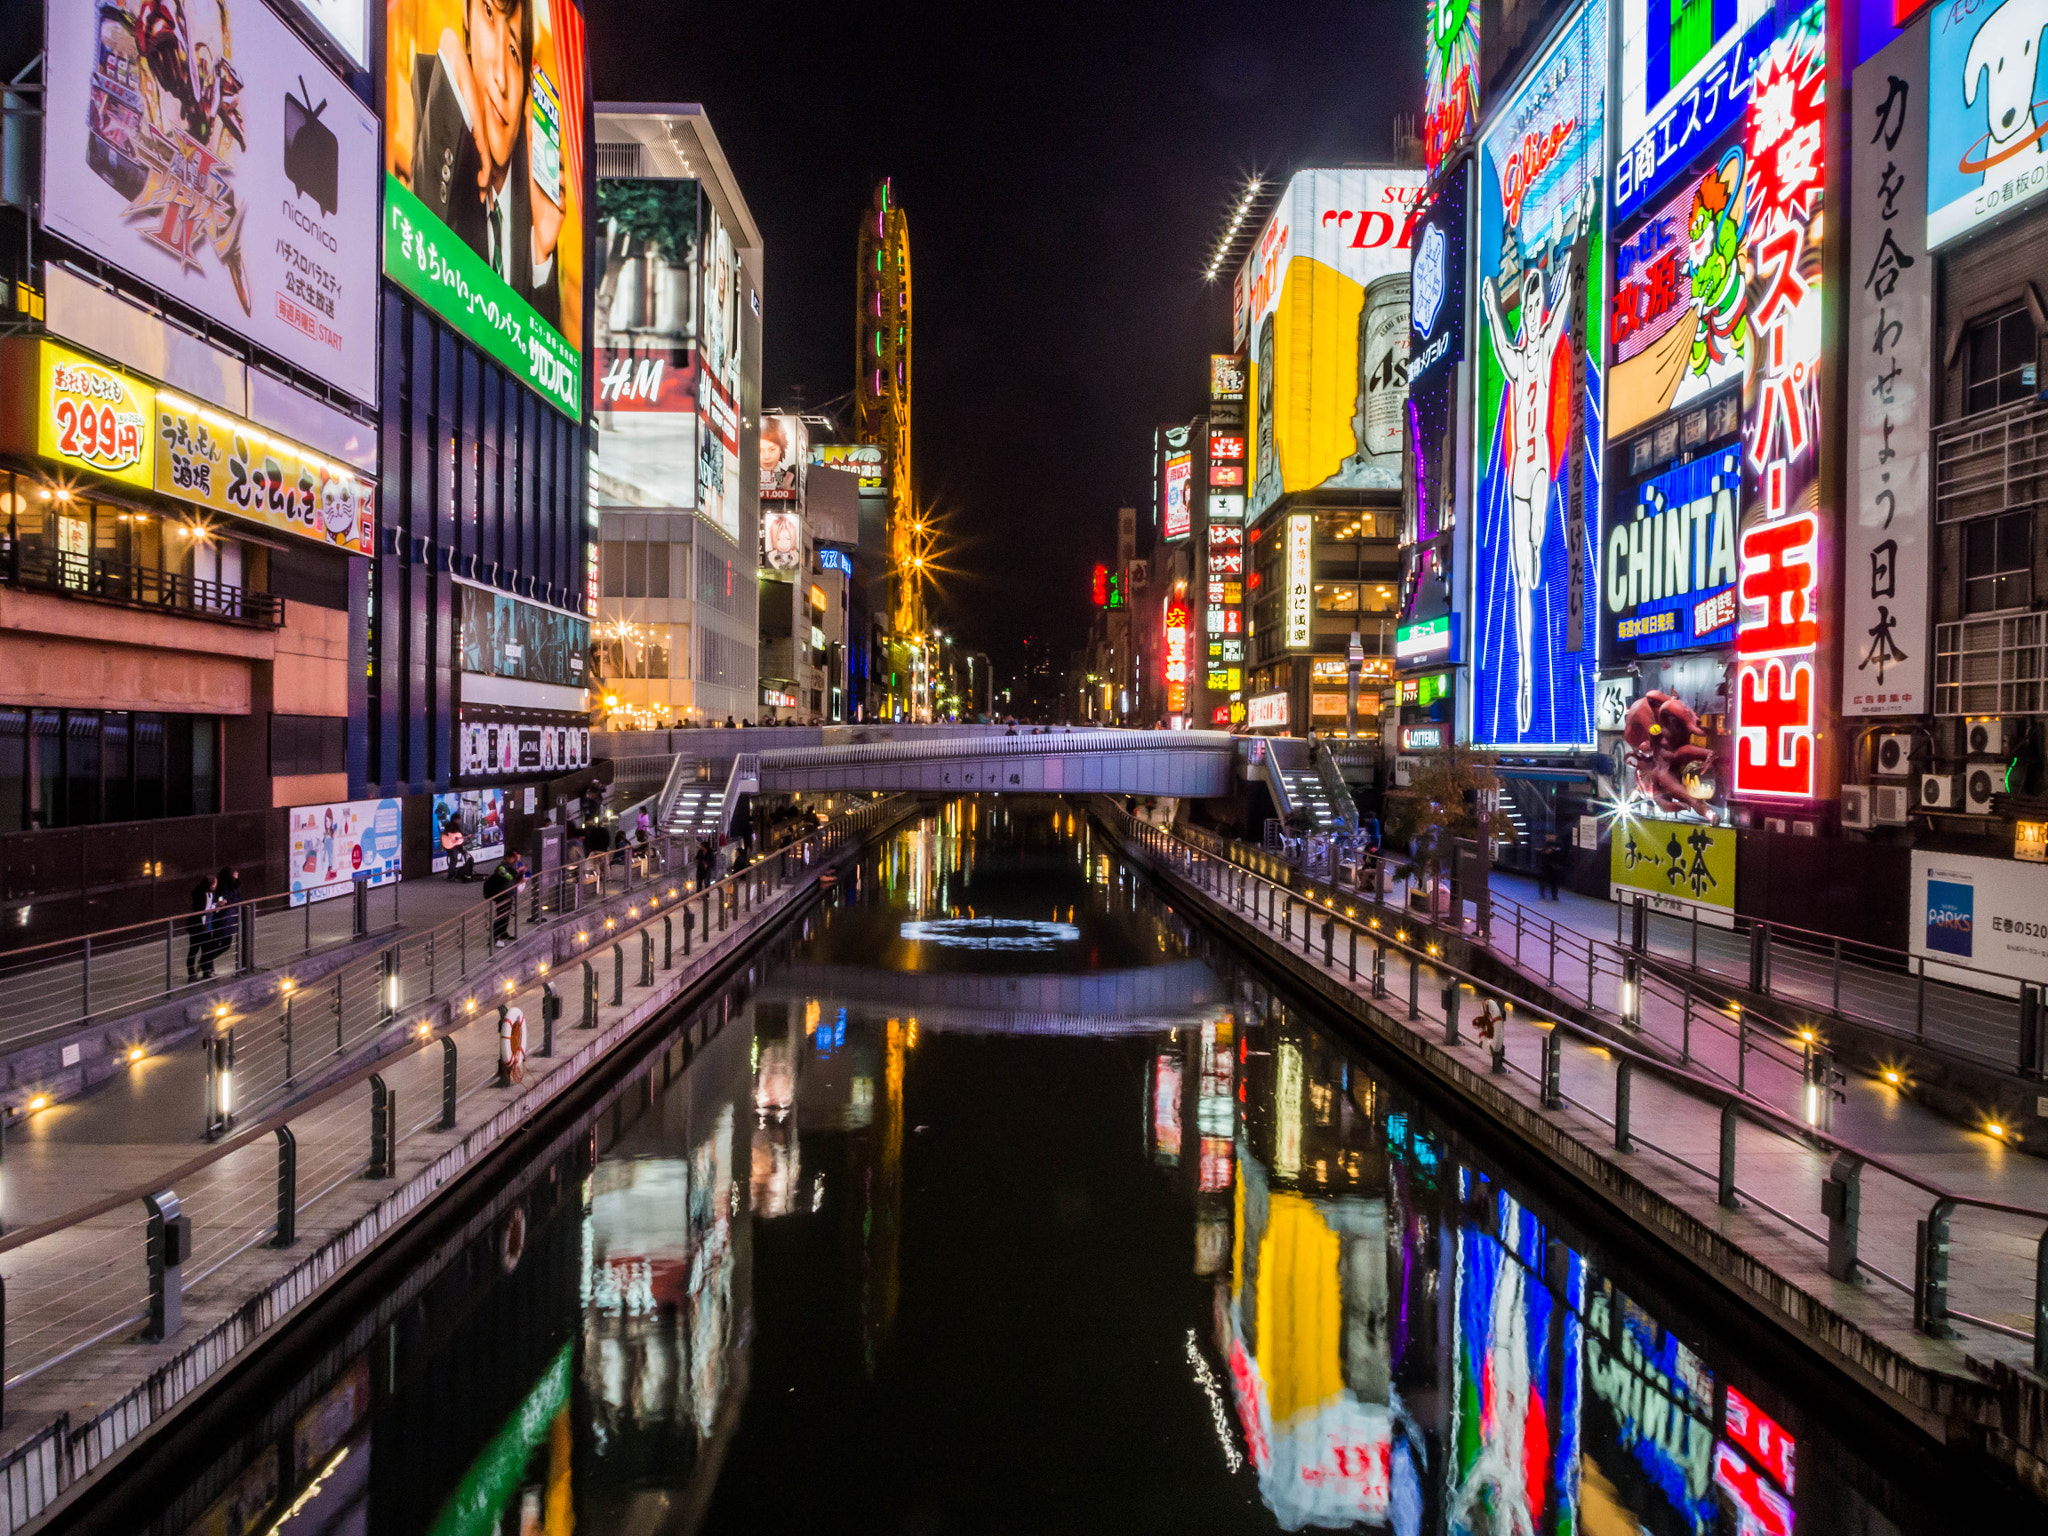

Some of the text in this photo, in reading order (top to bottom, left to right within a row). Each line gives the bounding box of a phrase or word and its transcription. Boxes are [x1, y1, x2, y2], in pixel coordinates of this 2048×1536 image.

[1753, 74, 1821, 201] 激安
[1504, 117, 1576, 228] Glico
[1974, 160, 2048, 216] この看板の
[282, 200, 338, 254] niconico
[1617, 217, 1671, 280] かぜに
[276, 238, 343, 299] パチスロバラエティ
[285, 271, 335, 320] 公式生放送
[1611, 248, 1676, 344] 改源
[278, 298, 343, 352] 毎週月曜日 START
[529, 335, 574, 411] サロンパス
[601, 358, 665, 402] H&M
[1858, 75, 1914, 687] 力を合わせよう日本
[57, 400, 140, 461] 299円
[161, 413, 222, 463] うまいもん
[1526, 373, 1538, 465] グリコ
[1570, 263, 1587, 632] みんなに笑顔を届けたい。
[172, 453, 212, 498] 酒場
[227, 434, 316, 527] えこひいき
[1735, 218, 1818, 797] スーパー玉出
[1607, 488, 1738, 613] CHINTA
[1618, 611, 1675, 640] 毎週水曜日発売
[1694, 598, 1718, 637] 賃貸
[1853, 693, 1912, 705] 広告募集中
[1410, 728, 1440, 747] LOTTERIA
